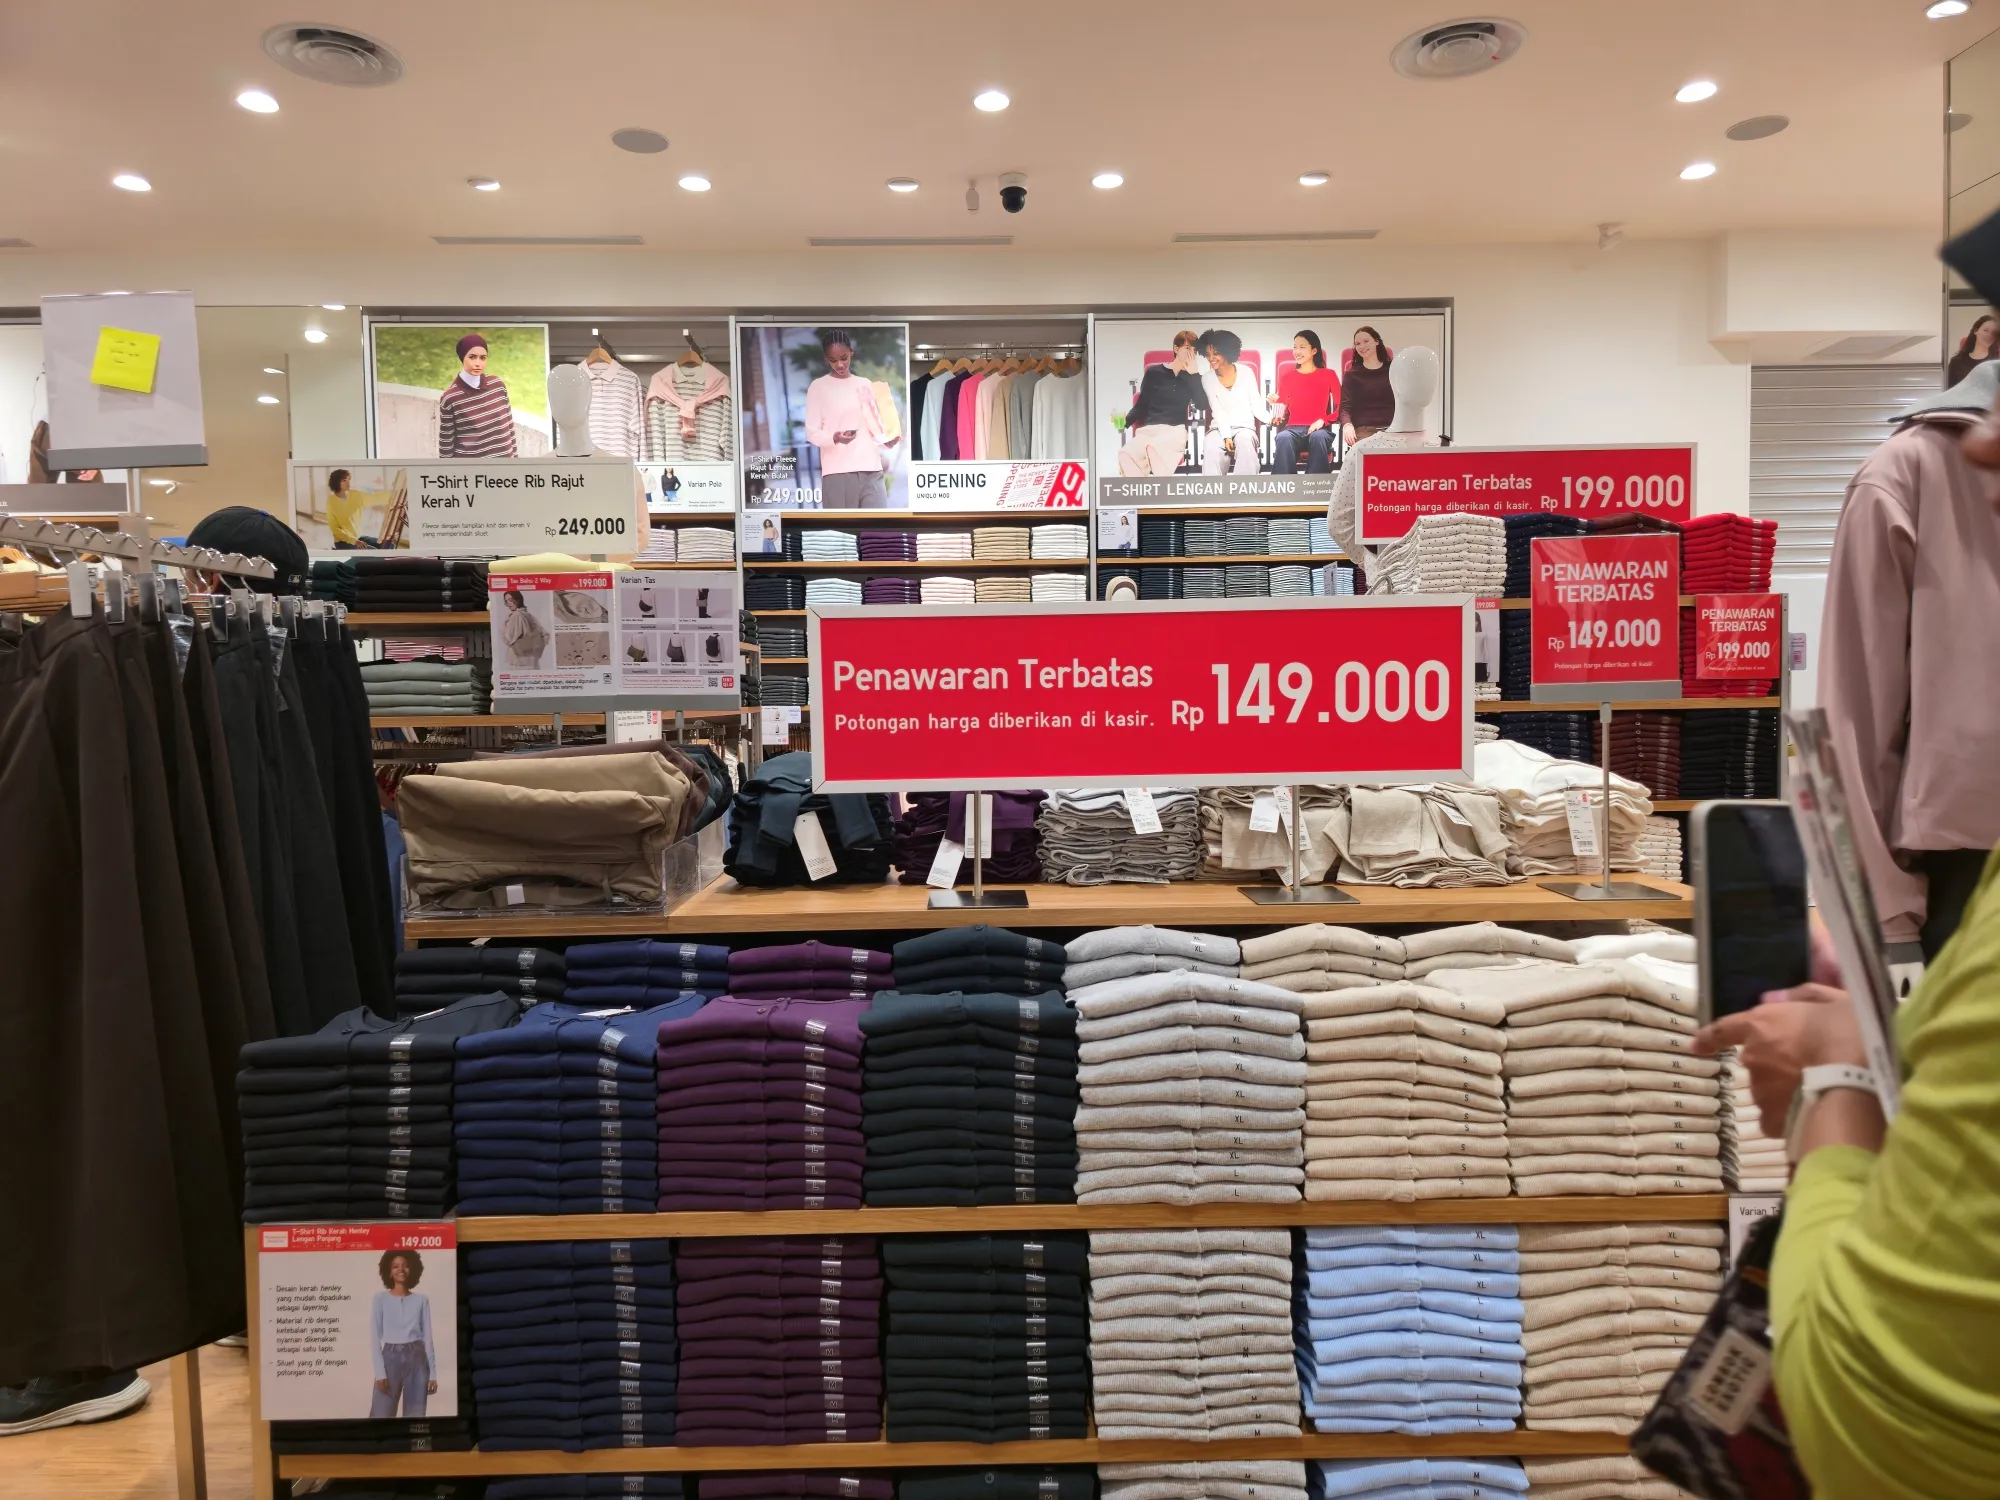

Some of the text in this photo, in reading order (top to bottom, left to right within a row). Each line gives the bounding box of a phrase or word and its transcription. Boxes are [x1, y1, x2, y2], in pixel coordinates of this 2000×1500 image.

[751, 464, 767, 472] Rajut
[421, 475, 584, 490] T-Shirt Fleece Rib Rajut
[917, 473, 986, 488] OPENING
[1367, 473, 1532, 492] Penawaran Terbatas
[1104, 481, 1295, 496] T-SHIRT LENGAN PANJANG
[1541, 474, 1684, 512] Rp 199.000
[422, 495, 474, 508] Kerah V
[751, 488, 822, 504] Rp 249.000
[1368, 502, 1532, 513] Potongan harga diberikan di kasir.
[545, 518, 624, 537] Rp 249.000
[1541, 560, 1668, 582] PENAWARAN
[579, 578, 607, 587] 199.000
[1554, 583, 1654, 603] TERBATAS
[1701, 608, 1775, 620] PENAWARAN
[1709, 620, 1766, 632] TERBATAS
[1548, 618, 1661, 653] Rp 149.000
[1706, 641, 1770, 660] Rp 199.000
[833, 657, 1153, 691] Penawaran Terbatas
[1171, 660, 1450, 732] Rp 149.000
[835, 710, 1154, 733] Potongan harga diberikan di kasir.
[1233, 1015, 1242, 1023] XL
[1235, 1063, 1245, 1071] XL
[1740, 1207, 1766, 1215] Varian
[401, 1236, 441, 1247] 149.000
[1473, 1253, 1483, 1261] XL
[1674, 1250, 1679, 1258] L
[1673, 1272, 1678, 1280] L
[1675, 1296, 1679, 1304] L
[1674, 1319, 1679, 1327] L
[325, 1359, 347, 1367] dengan
